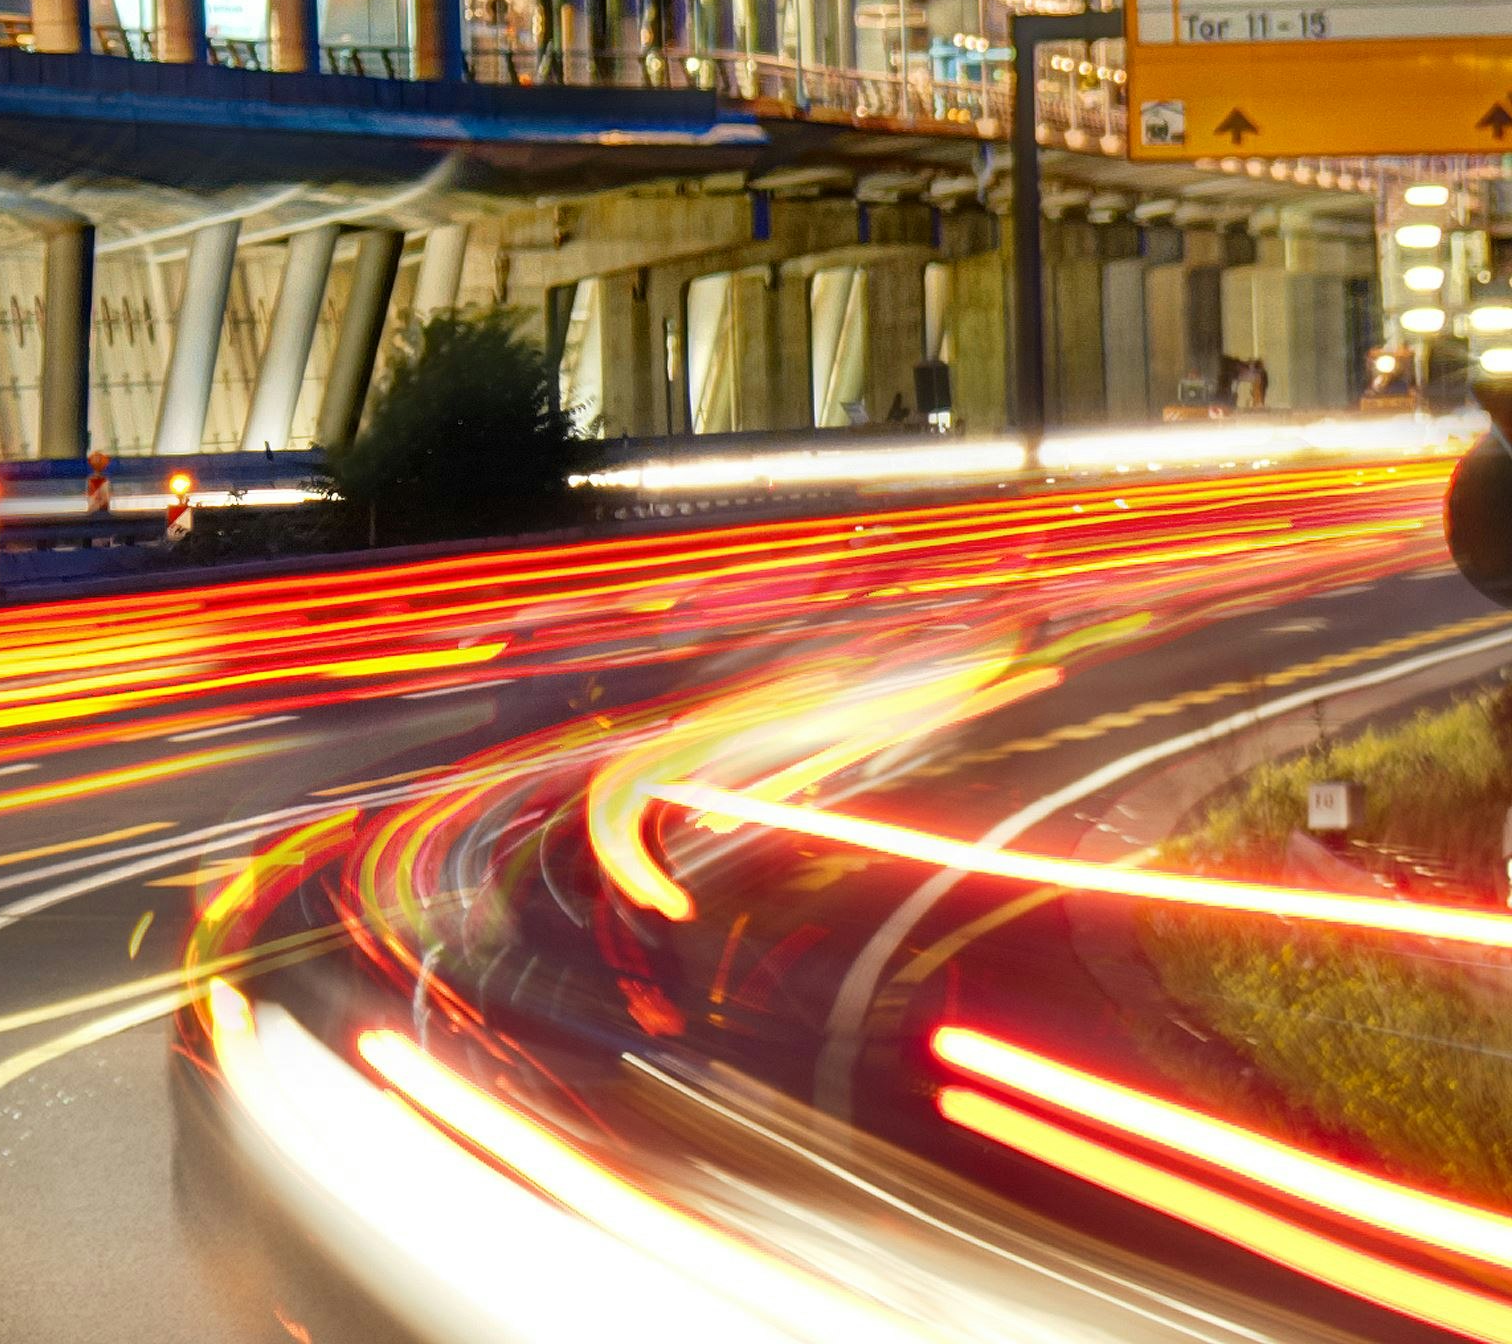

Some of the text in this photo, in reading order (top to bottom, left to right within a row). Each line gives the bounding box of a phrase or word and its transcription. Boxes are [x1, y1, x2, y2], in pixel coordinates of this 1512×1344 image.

[1184, 13, 1229, 40] Tor
[1247, 12, 1270, 39] 11
[1301, 10, 1326, 39] 15
